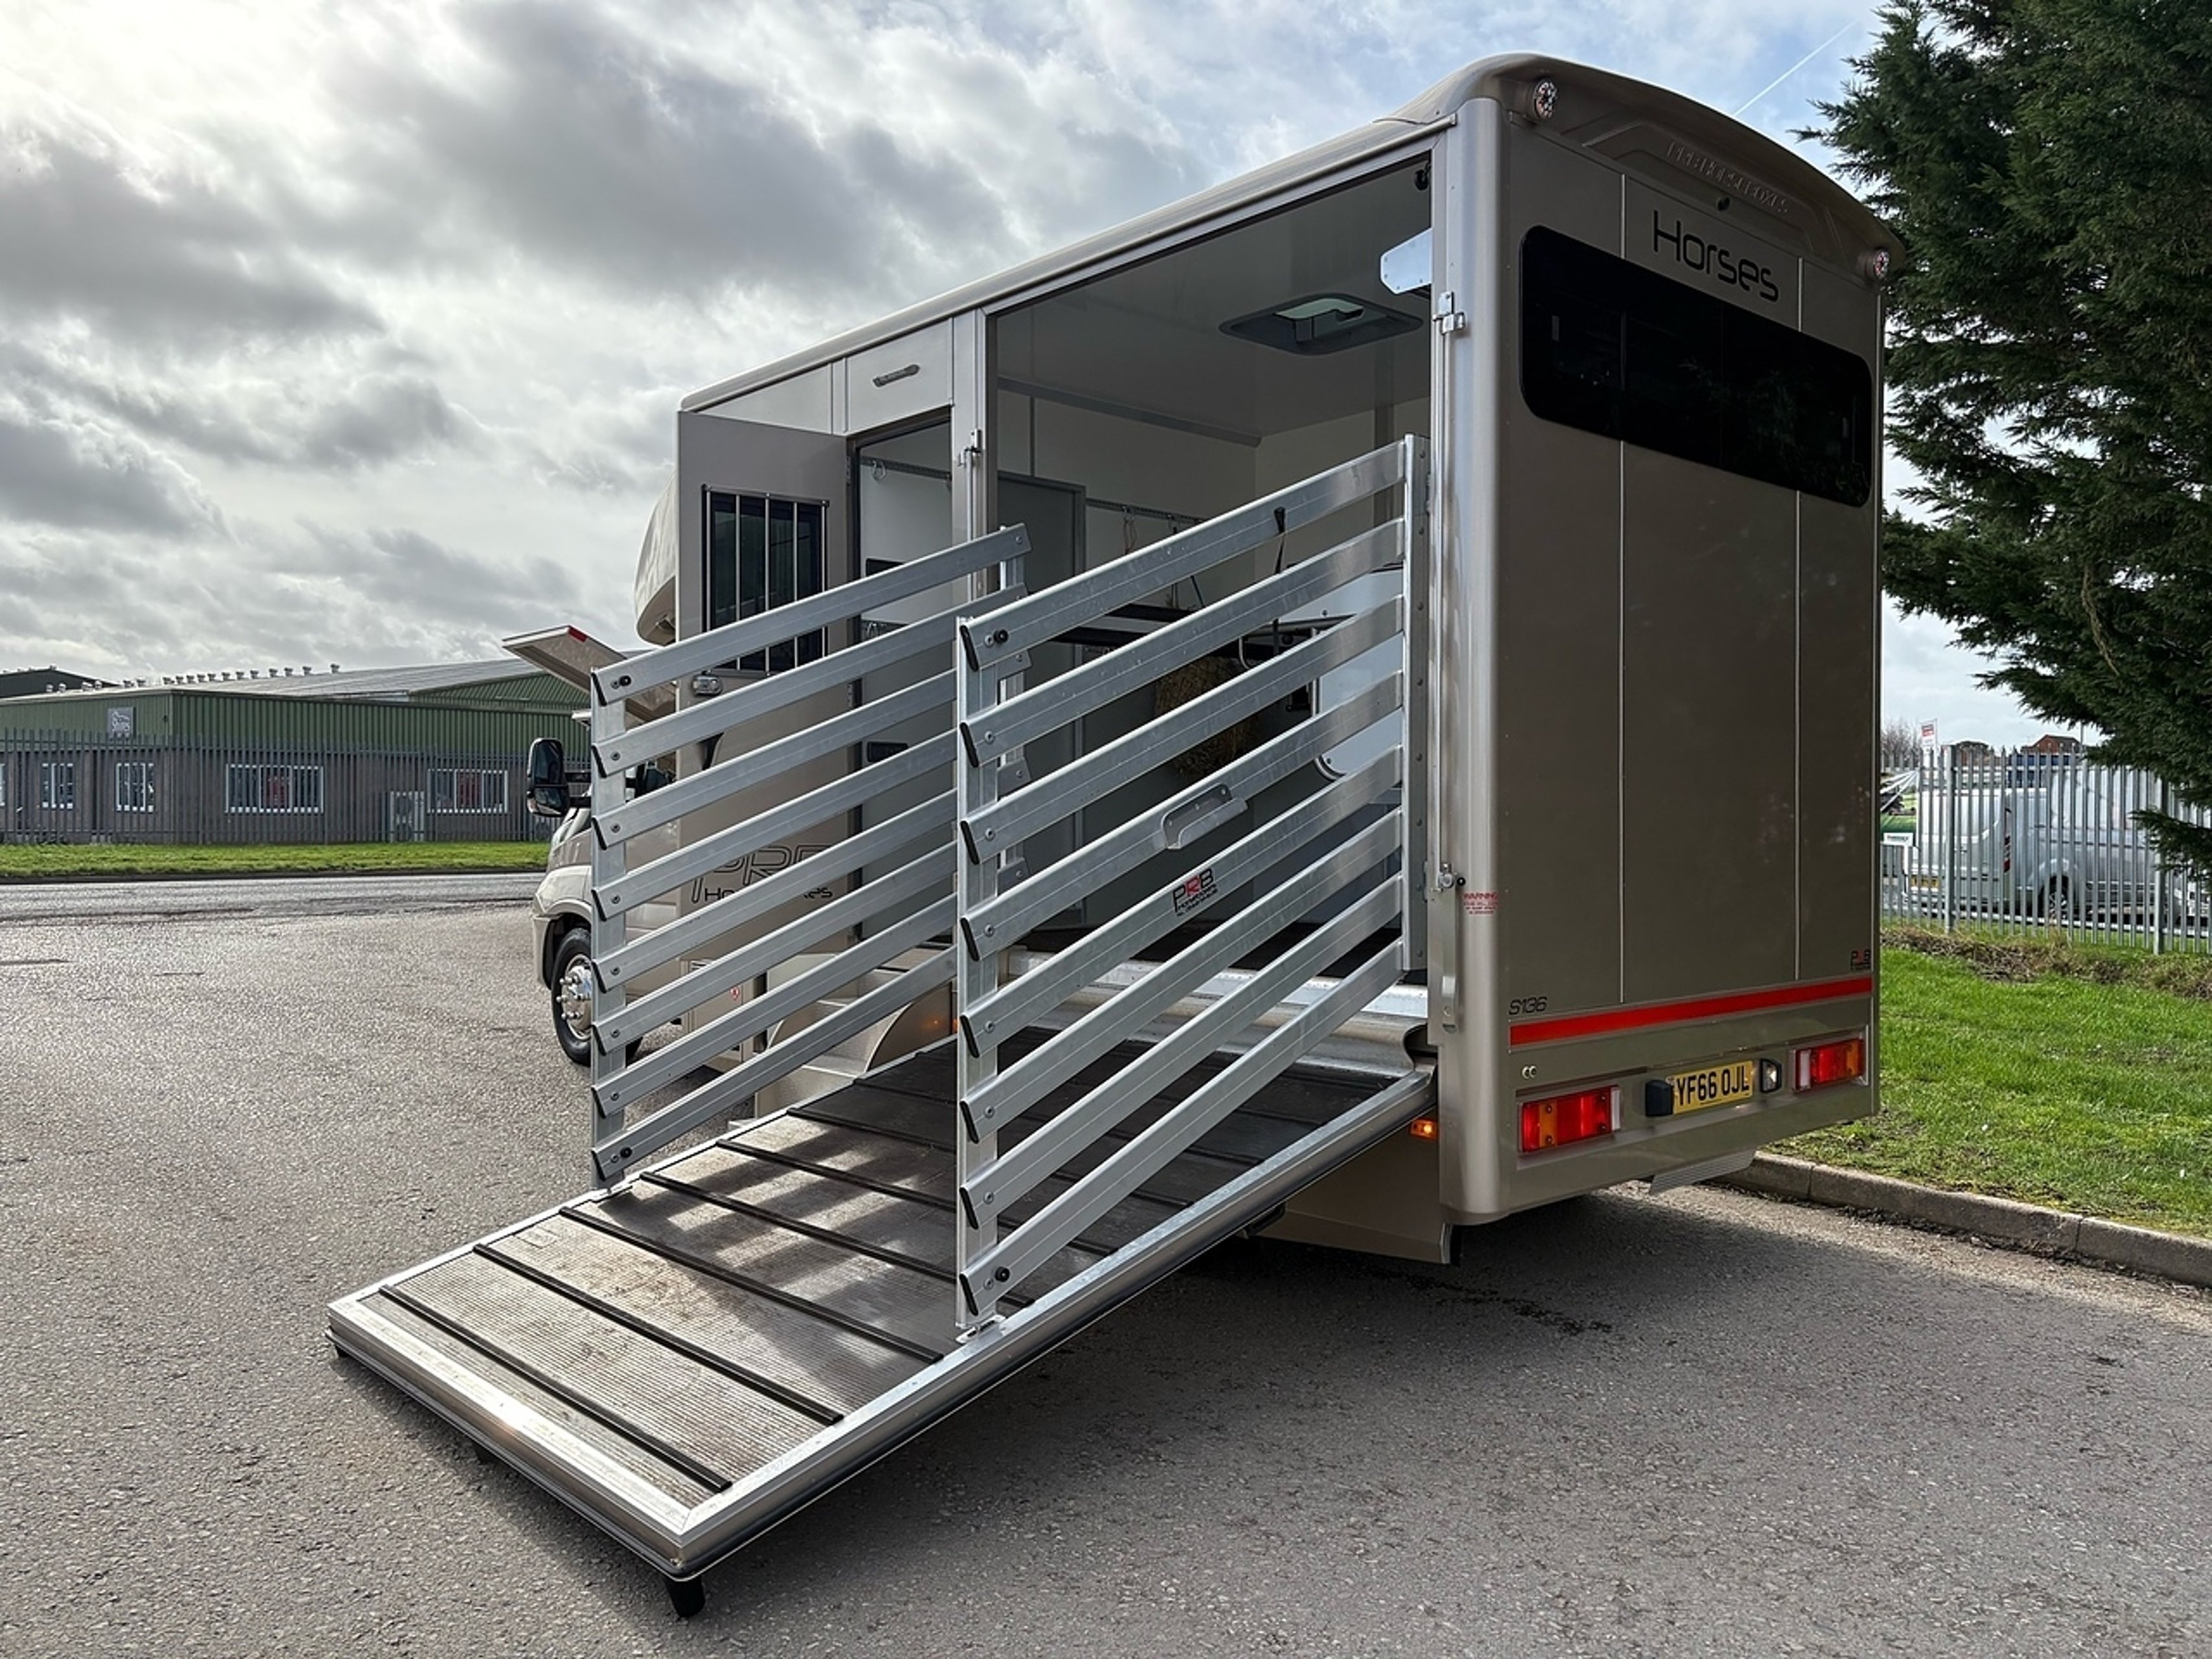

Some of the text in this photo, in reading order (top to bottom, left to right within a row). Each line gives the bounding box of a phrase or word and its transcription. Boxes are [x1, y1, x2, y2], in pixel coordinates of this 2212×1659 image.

[1653, 209, 1778, 302] Horses
[1173, 868, 1214, 912] PRB
[1508, 996, 1548, 1015] S136
[1677, 1065, 1750, 1106] YF66 OJL
